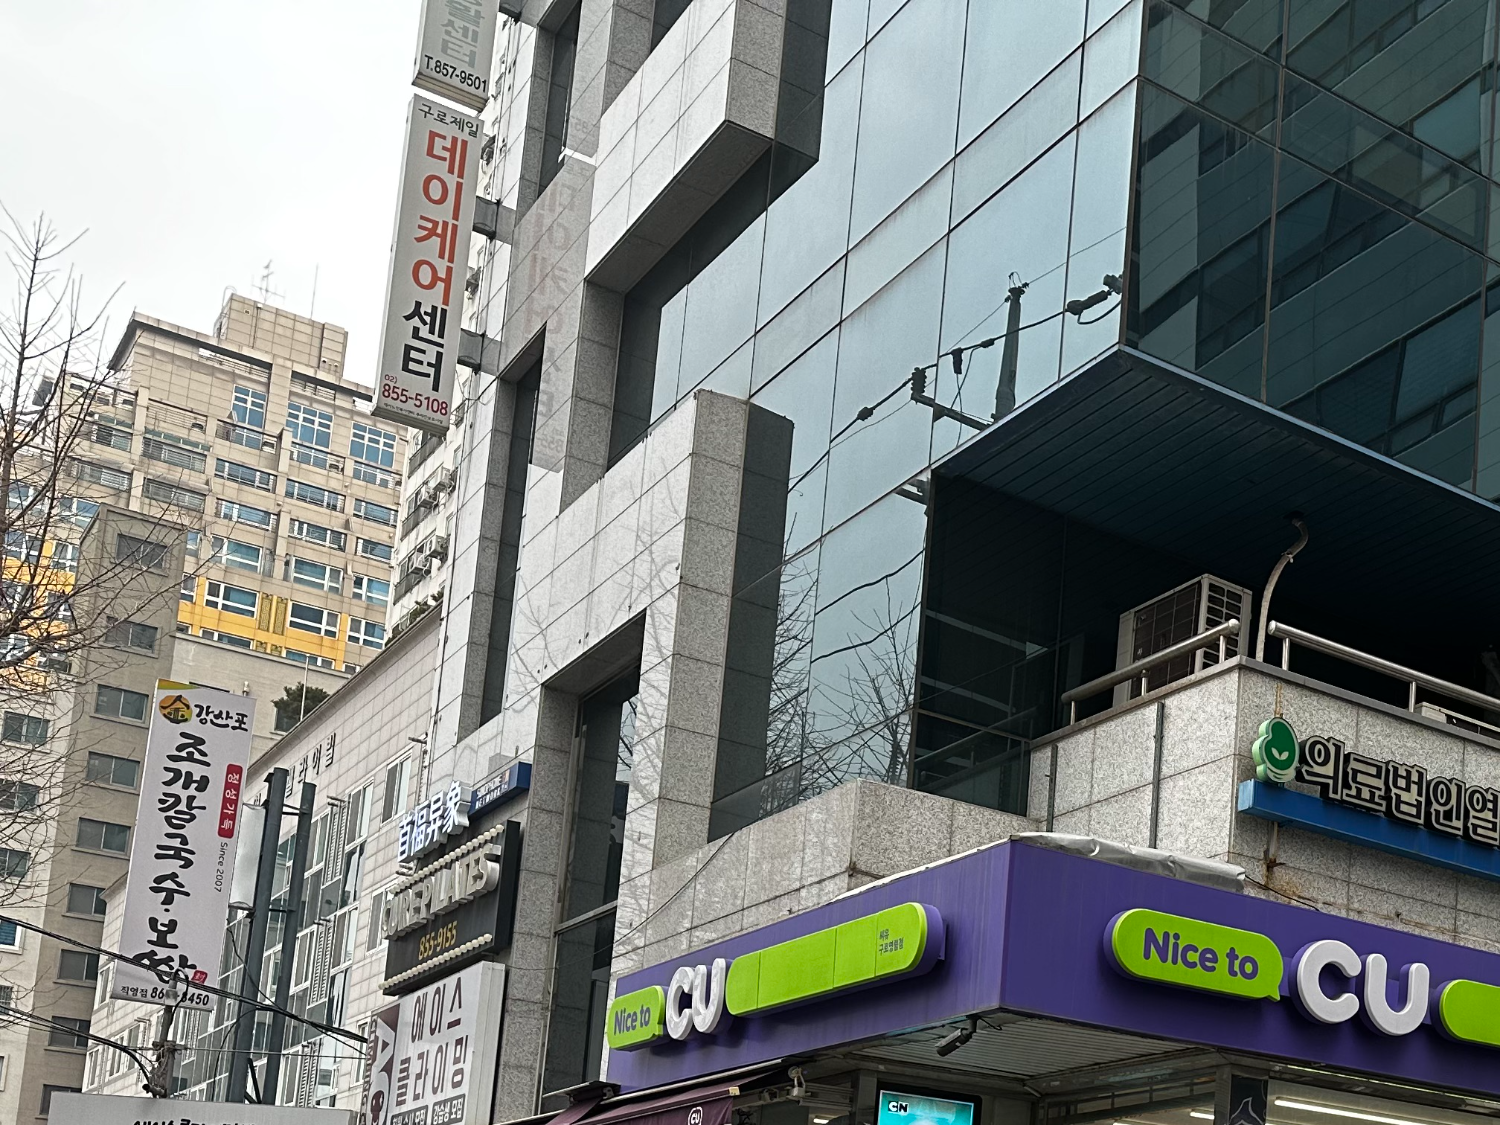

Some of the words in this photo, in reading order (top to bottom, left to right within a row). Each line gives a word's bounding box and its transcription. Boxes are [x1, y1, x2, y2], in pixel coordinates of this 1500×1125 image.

[424, 54, 487, 93] T.857-9501
[418, 103, 479, 138] 구로제일
[402, 129, 469, 393] 데이케어센터
[382, 383, 449, 416] 855-5108
[194, 704, 248, 732] 강산포
[217, 841, 228, 868] Since
[213, 870, 223, 893] 2007
[418, 920, 457, 961] 855-9155
[120, 986, 148, 998] 직영점
[614, 1008, 638, 1036] Nice
[639, 1003, 651, 1028] to
[665, 957, 727, 1041] CU
[1143, 927, 1218, 973] Nice
[1227, 946, 1259, 981] to
[1294, 939, 1430, 1036] CU
[411, 977, 462, 1044] 에이스
[395, 1034, 469, 1108] 클라이밍
[888, 1101, 909, 1114] CN
